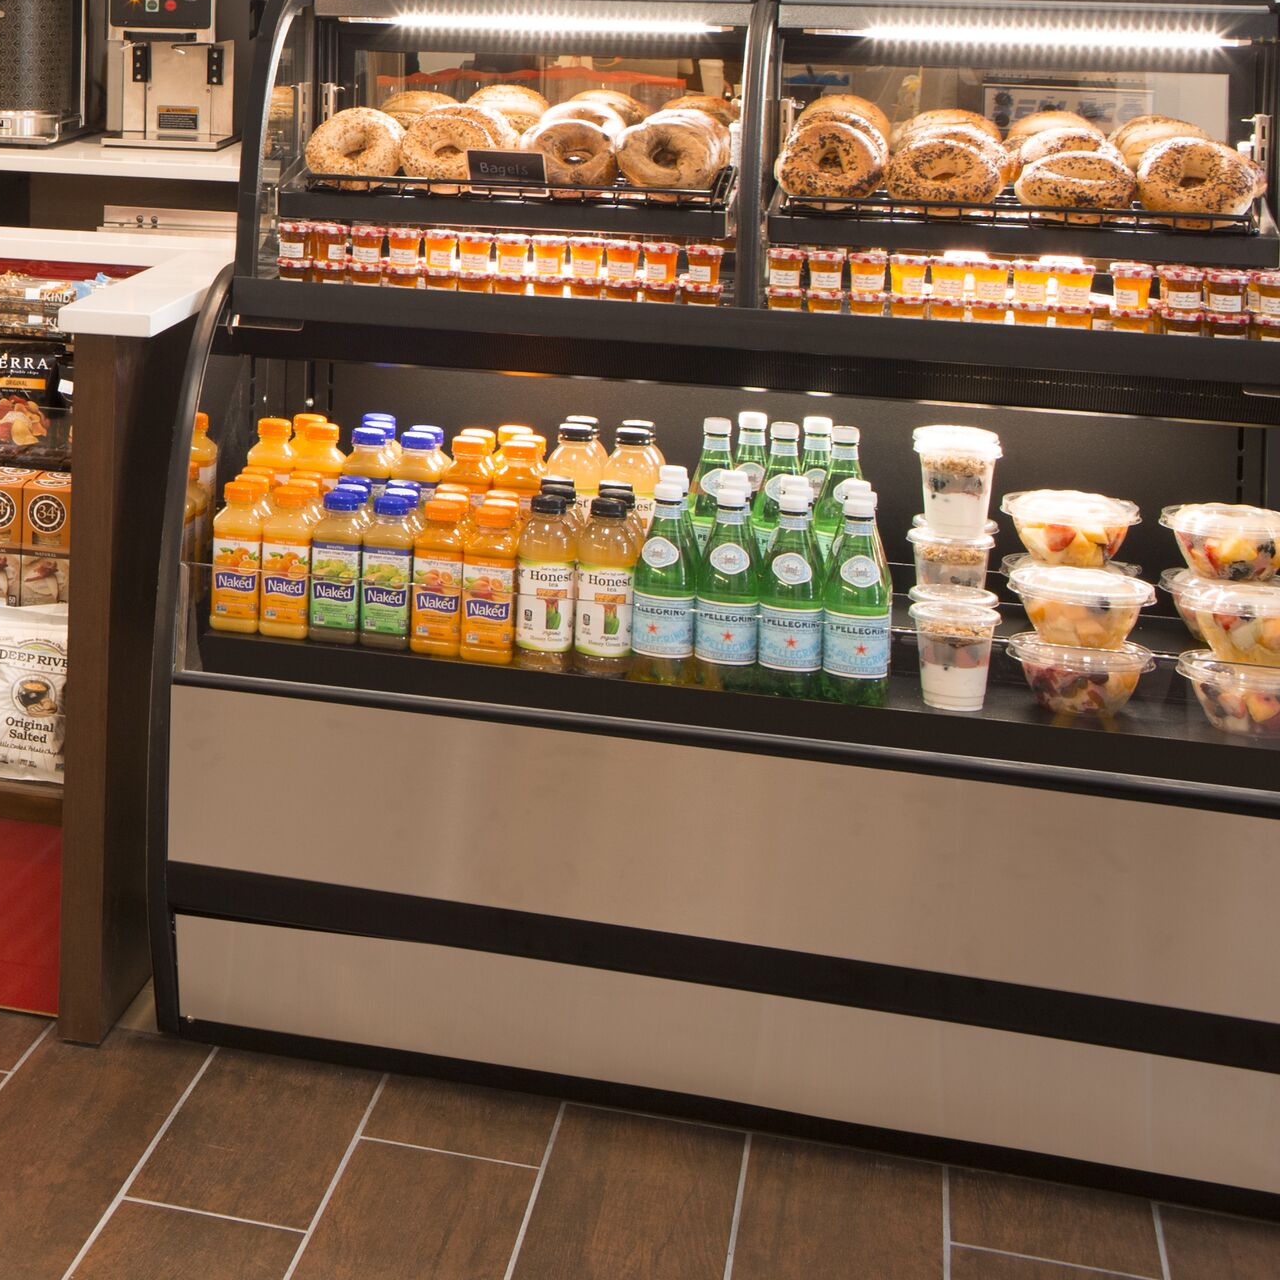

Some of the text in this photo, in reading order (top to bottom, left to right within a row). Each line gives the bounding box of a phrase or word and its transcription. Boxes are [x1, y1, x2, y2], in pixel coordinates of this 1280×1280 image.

[480, 161, 529, 176] Bagels
[44, 291, 71, 303] KIND
[218, 574, 254, 589] Naked
[530, 570, 572, 582] Honest
[589, 574, 632, 587] Honest
[267, 579, 303, 594] Naked
[316, 584, 352, 599] Naked
[367, 590, 404, 605] Naked
[419, 595, 457, 611] Naked
[470, 603, 507, 619] Naked
[38, 653, 68, 670] RIVE
[5, 716, 55, 734] Original
[9, 729, 48, 744] Salted
